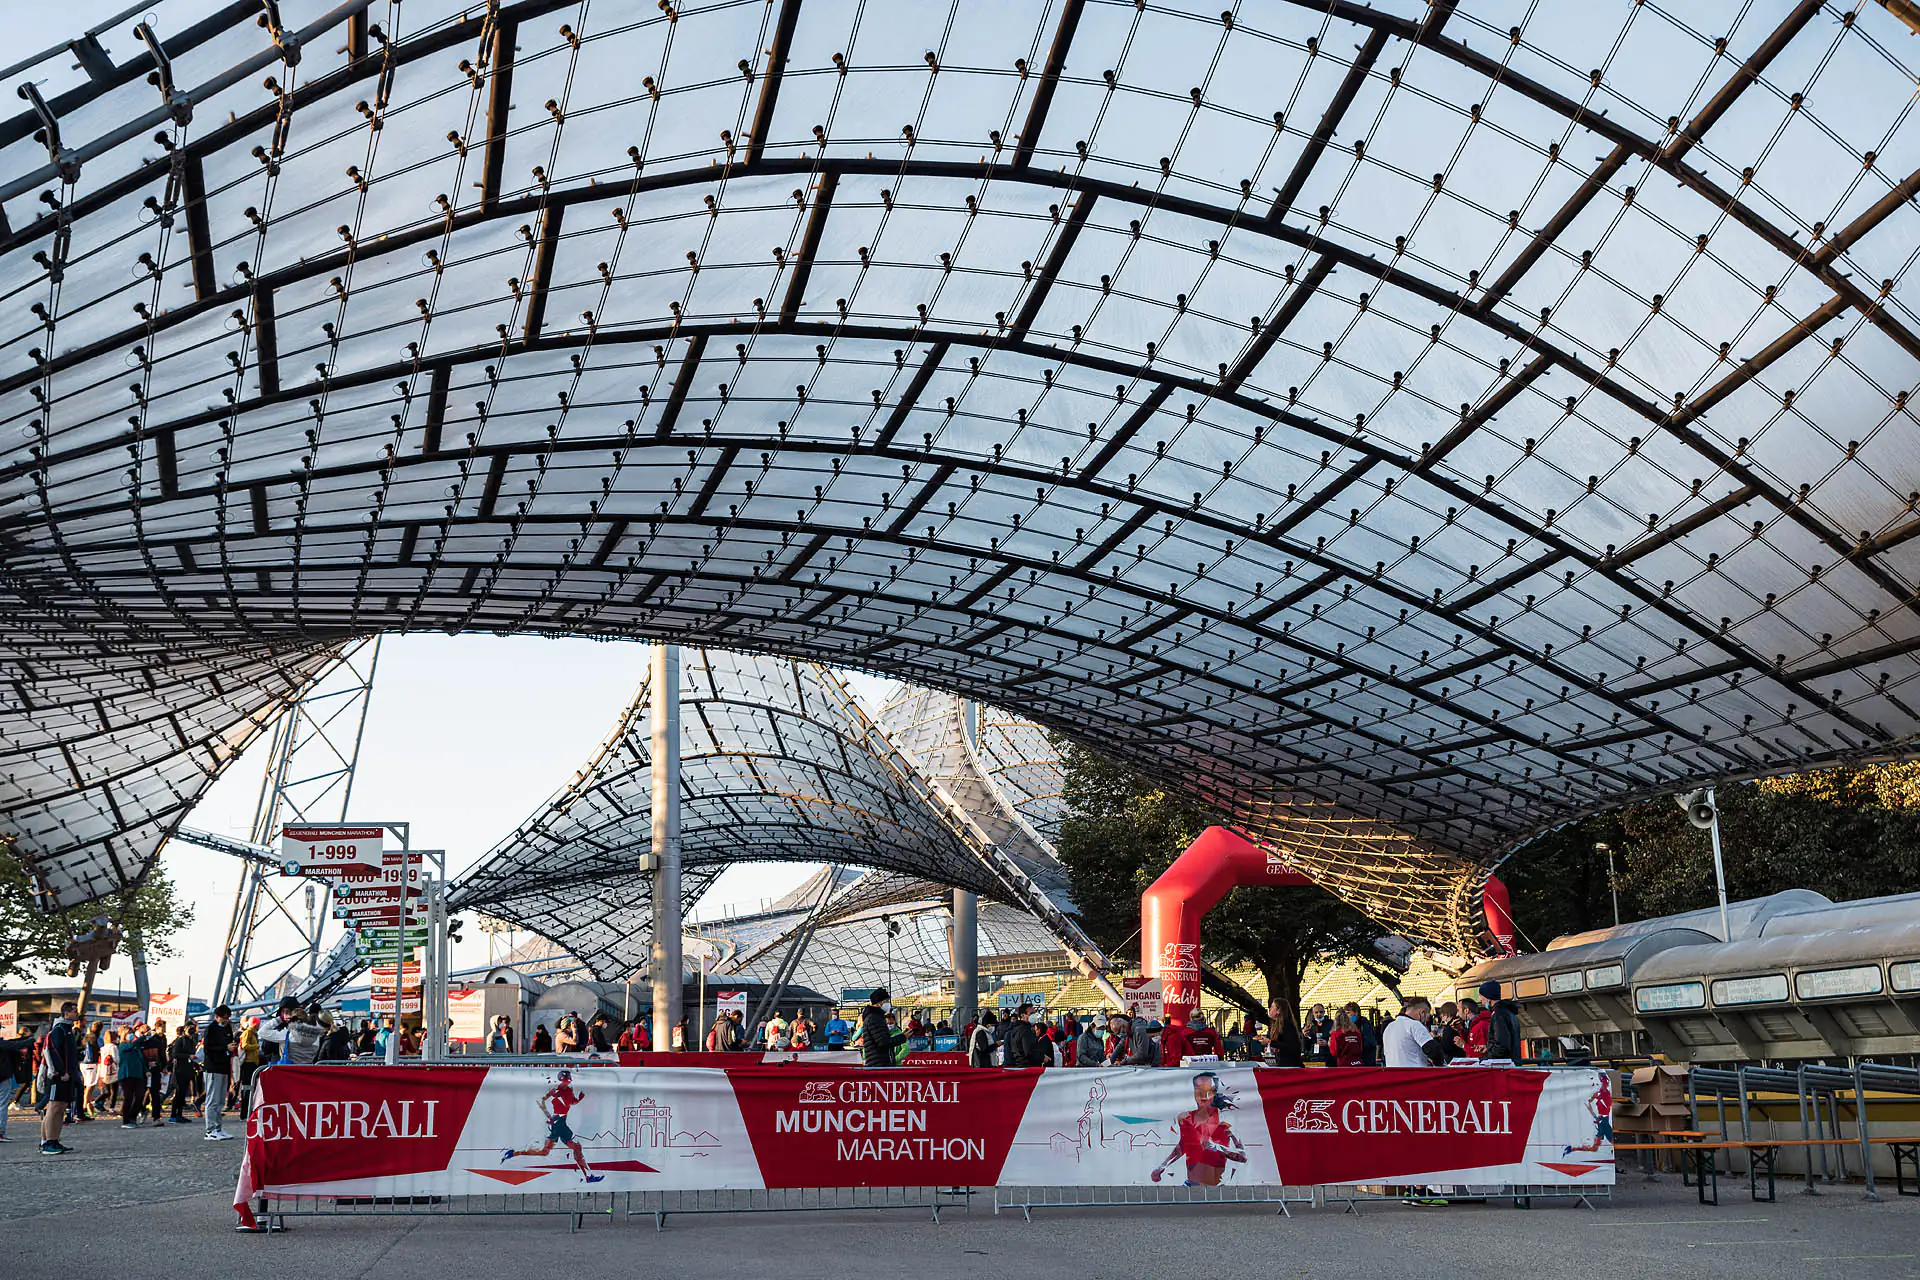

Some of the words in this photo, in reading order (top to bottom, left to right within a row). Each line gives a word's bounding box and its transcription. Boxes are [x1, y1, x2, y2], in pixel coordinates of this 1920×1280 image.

[308, 845, 357, 860] 1-999
[355, 889, 388, 897] MARATHON
[373, 976, 419, 985] 10000-0999
[1125, 991, 1161, 1001] EINGANG
[1162, 983, 1198, 1008] Vitality
[151, 1006, 184, 1016] EINGANG
[1775, 1062, 1785, 1070] 24
[839, 1081, 960, 1103] GENERALI
[775, 1109, 927, 1133] MÜNCHEN
[1342, 1099, 1514, 1135] GENERALI
[837, 1138, 985, 1161] MARATHON
